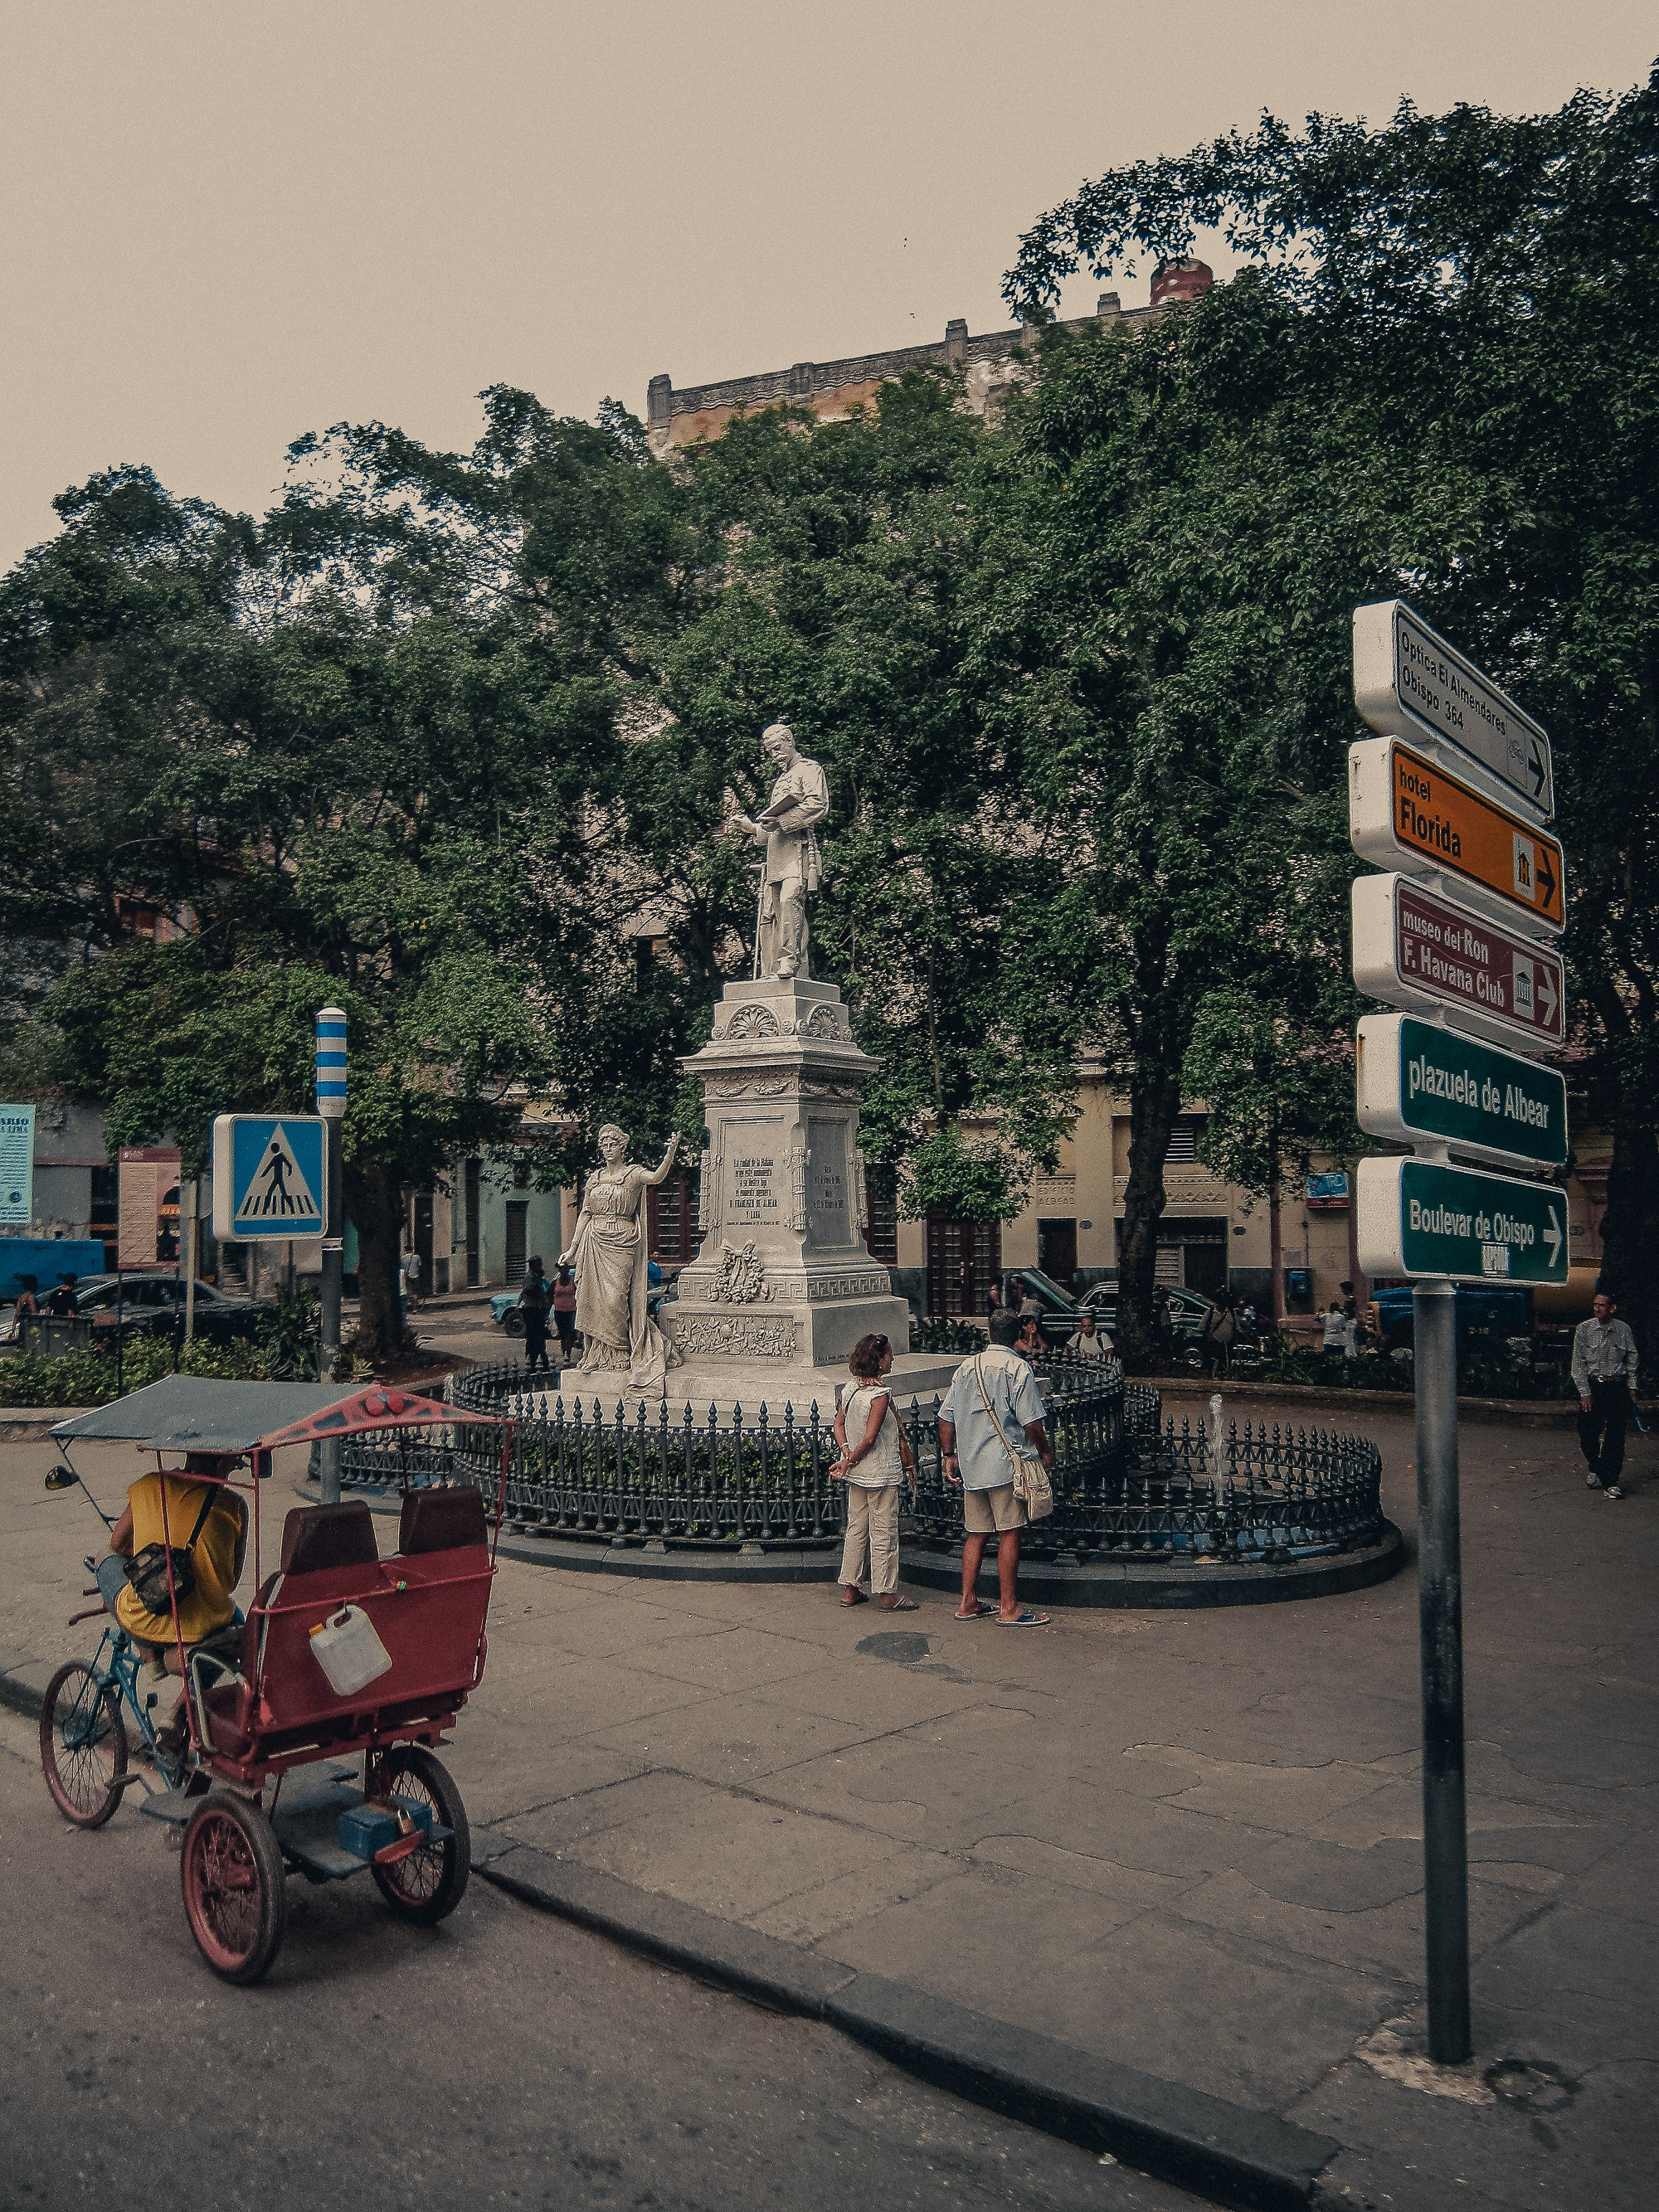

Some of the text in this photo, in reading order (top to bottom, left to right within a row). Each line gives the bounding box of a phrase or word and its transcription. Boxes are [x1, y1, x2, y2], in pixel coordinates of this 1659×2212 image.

[1402, 631, 1506, 736] Optica El Almendares
[1402, 665, 1464, 730] Obispo 364
[1399, 763, 1431, 803] hotel
[1400, 795, 1462, 859] Florida
[1404, 911, 1489, 965] museo del Ron
[1404, 937, 1505, 1007] F. Havana Club
[1408, 1054, 1550, 1129] plazuela de Albear
[1409, 1198, 1535, 1251] Boulevar de Obispo
